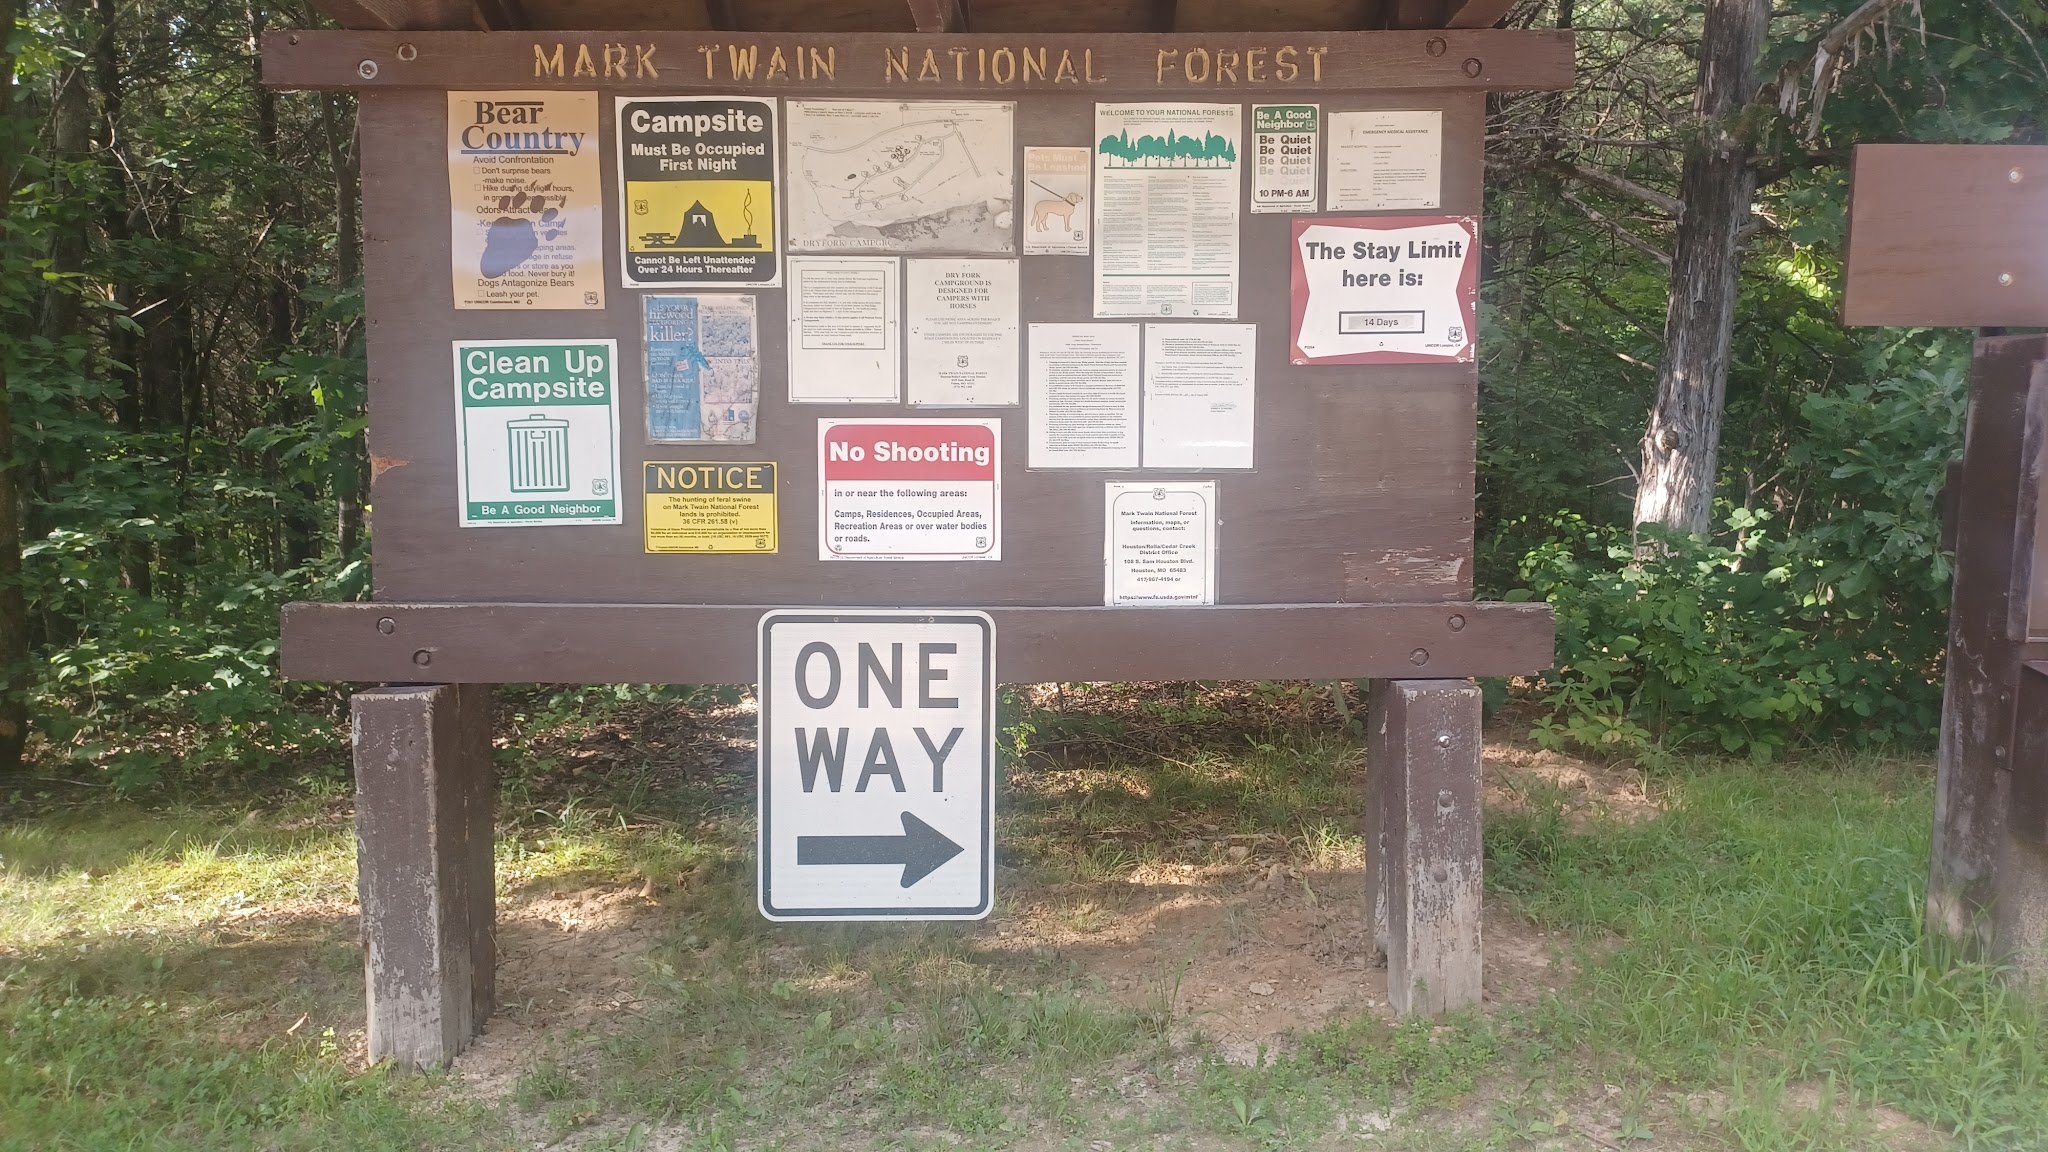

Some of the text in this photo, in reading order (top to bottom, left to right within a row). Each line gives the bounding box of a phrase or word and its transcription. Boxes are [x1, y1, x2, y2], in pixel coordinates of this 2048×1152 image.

[533, 43, 1329, 84] MARK TWAIN NATIONAL FOREST
[474, 101, 544, 124] Bear
[1202, 109, 1234, 117] FORESTS
[1256, 110, 1312, 120] Be A Good
[630, 108, 764, 137] Campsite
[1256, 120, 1304, 131] Neighbor
[461, 125, 585, 156] Country
[1259, 135, 1312, 145] Be Quiet
[631, 142, 765, 157] Must Be Occupied
[1259, 145, 1312, 156] Be Quiet
[473, 156, 554, 164] Avoid Confrontation
[1259, 155, 1312, 166] Be Quiet
[660, 158, 737, 173] First Night
[481, 167, 500, 175] Don't
[502, 168, 530, 176] surprise
[1259, 166, 1312, 176] Be Quiet
[483, 184, 575, 193] Hike hours,
[1259, 189, 1310, 198] 10 PM-6 AM
[476, 206, 501, 214] Odors
[503, 206, 531, 214] Attract
[1306, 240, 1462, 263] The Stay Limit
[634, 255, 756, 264] Cannot Be Left Unattended
[561, 264, 574, 272] you
[637, 265, 754, 274] Over 24 Hours Thereafter
[528, 270, 567, 279] Never bury
[1342, 268, 1424, 287] here is:
[477, 279, 575, 289] Dogs Antagonize Bears
[934, 279, 984, 287] CAMPGROUND
[486, 290, 540, 301] Leash your pet.
[666, 304, 689, 312] YOUR
[1364, 318, 1399, 328] 14 Days
[650, 325, 694, 342] killer?
[466, 349, 604, 378] Clean Up
[467, 376, 605, 403] Campsite
[829, 441, 990, 467] No Shooting
[657, 466, 763, 489] NOTICE
[834, 489, 843, 497] in
[880, 489, 895, 497] the
[896, 489, 938, 499] following
[939, 490, 968, 498] areas:
[481, 503, 602, 516] Be A Good Neighbor
[834, 509, 982, 520] Camps, Residences, Occupied Areas,
[706, 511, 741, 519] prohibited.
[834, 522, 878, 530] Recreation
[879, 522, 903, 530] Areas
[935, 522, 959, 530] water
[960, 521, 988, 530] bodies
[845, 534, 870, 542] roads.
[794, 641, 959, 710] ONE
[794, 727, 965, 793] WAY
